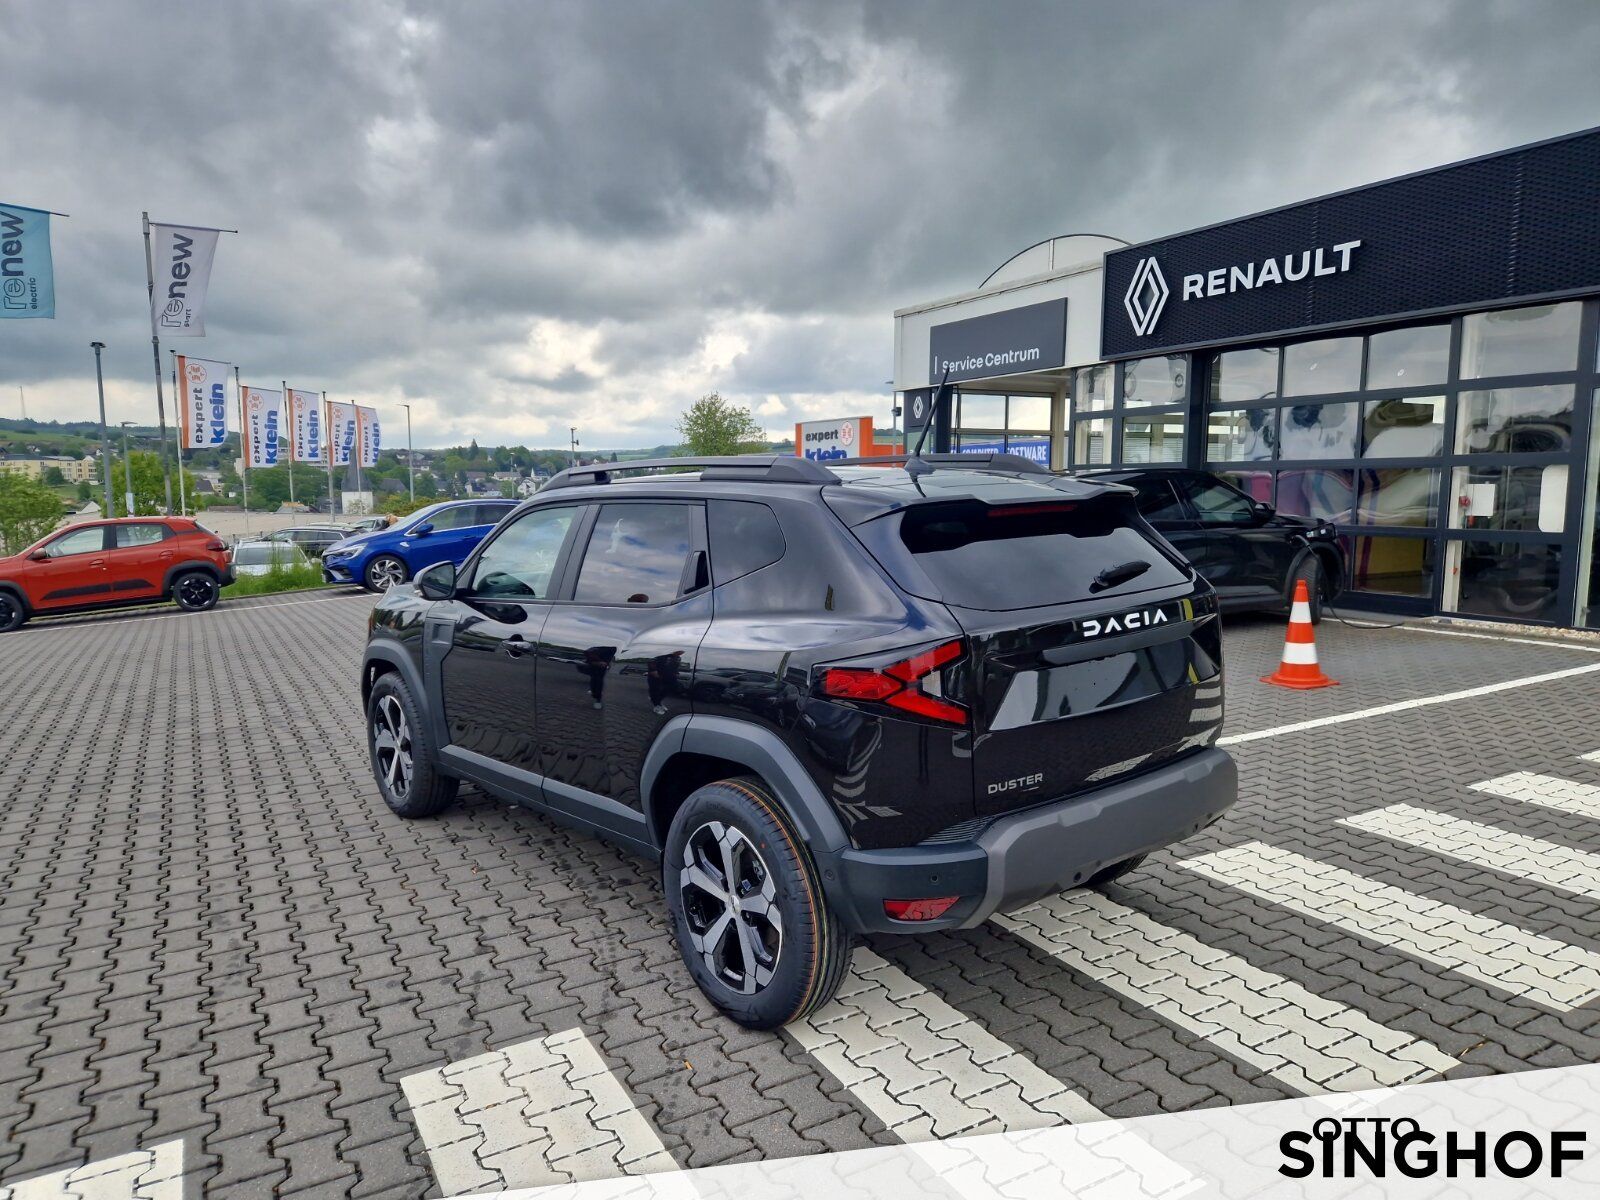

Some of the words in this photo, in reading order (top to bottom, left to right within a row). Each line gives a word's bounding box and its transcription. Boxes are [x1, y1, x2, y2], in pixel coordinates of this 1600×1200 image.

[0, 210, 26, 309] renew
[161, 233, 193, 327] renew
[1183, 240, 1361, 301] RENAULT
[28, 277, 38, 309] electric
[942, 355, 983, 374] Service
[984, 347, 1040, 367] Centrum
[193, 388, 205, 443] expert
[209, 383, 225, 443] klein
[264, 410, 278, 464] klein
[307, 409, 319, 458] klein
[805, 429, 838, 443] expert
[252, 414, 261, 463] expert
[341, 420, 355, 462] klein
[372, 422, 380, 463] klein
[1082, 608, 1168, 637] DACIA
[988, 772, 1044, 795] DUSTER
